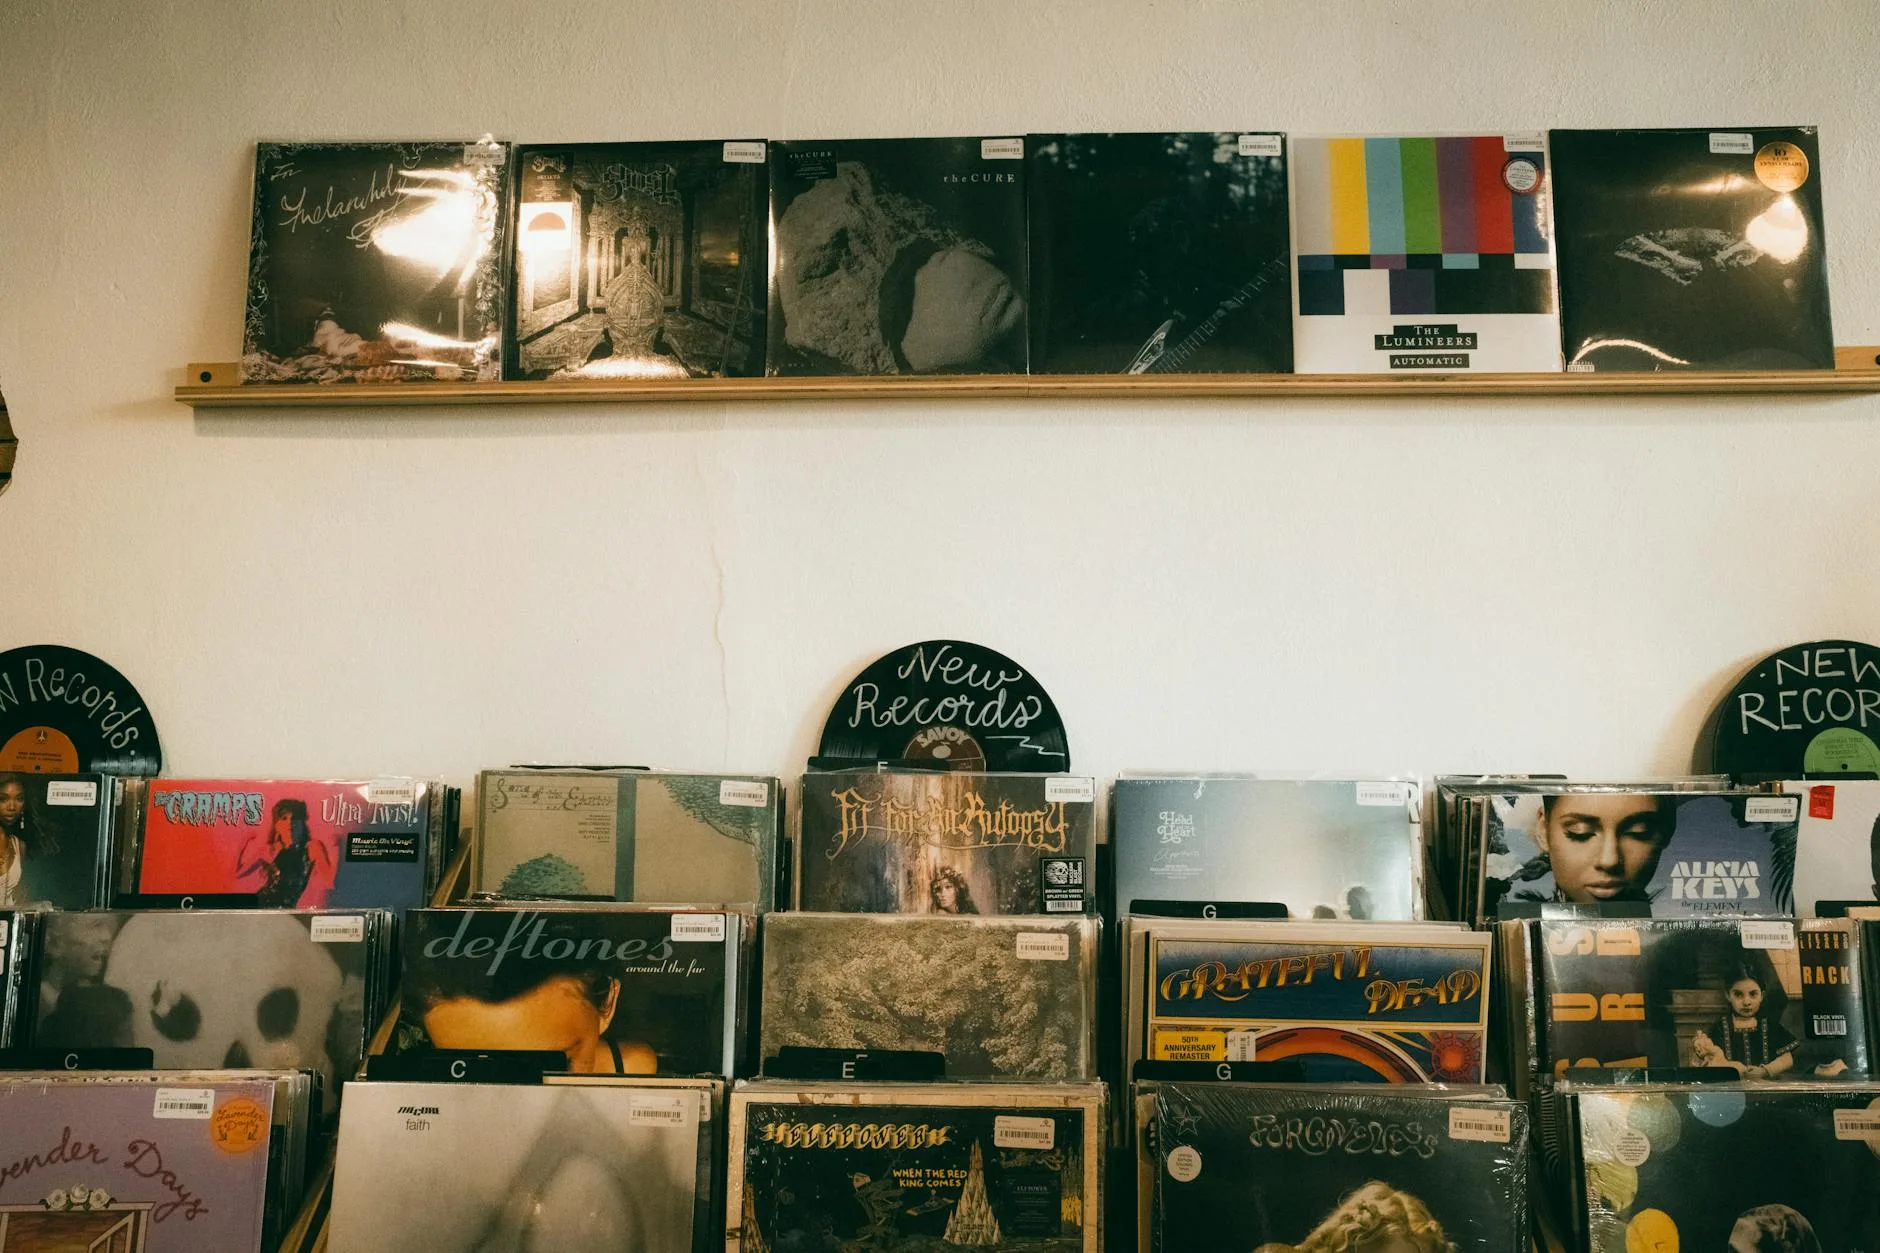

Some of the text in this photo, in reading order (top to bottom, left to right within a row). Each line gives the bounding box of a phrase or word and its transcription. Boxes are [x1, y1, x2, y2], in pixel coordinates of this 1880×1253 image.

[1393, 356, 1463, 365] AUTOMATIC
[898, 645, 1023, 690] New
[848, 682, 1042, 728] Records
[916, 727, 971, 748] SAVOY
[321, 792, 361, 825] Ultra
[1671, 877, 1760, 899] KEYS
[181, 897, 194, 910] C
[1203, 905, 1217, 919] G
[1692, 901, 1741, 911] ELEMENT
[423, 911, 673, 976] deftones
[625, 959, 706, 977] around the fur
[1160, 946, 1380, 1001] GRATEFUL
[1802, 965, 1850, 985] RACK
[1364, 968, 1481, 1014] DEAD
[64, 1053, 79, 1070] C
[450, 1060, 467, 1078] C
[842, 1062, 855, 1078] E
[1216, 1063, 1232, 1080] G
[406, 1119, 430, 1131] faith
[124, 1139, 209, 1224] Days
[893, 1168, 968, 1178] WHEN THE RED
[899, 1179, 961, 1187] KING COMES
